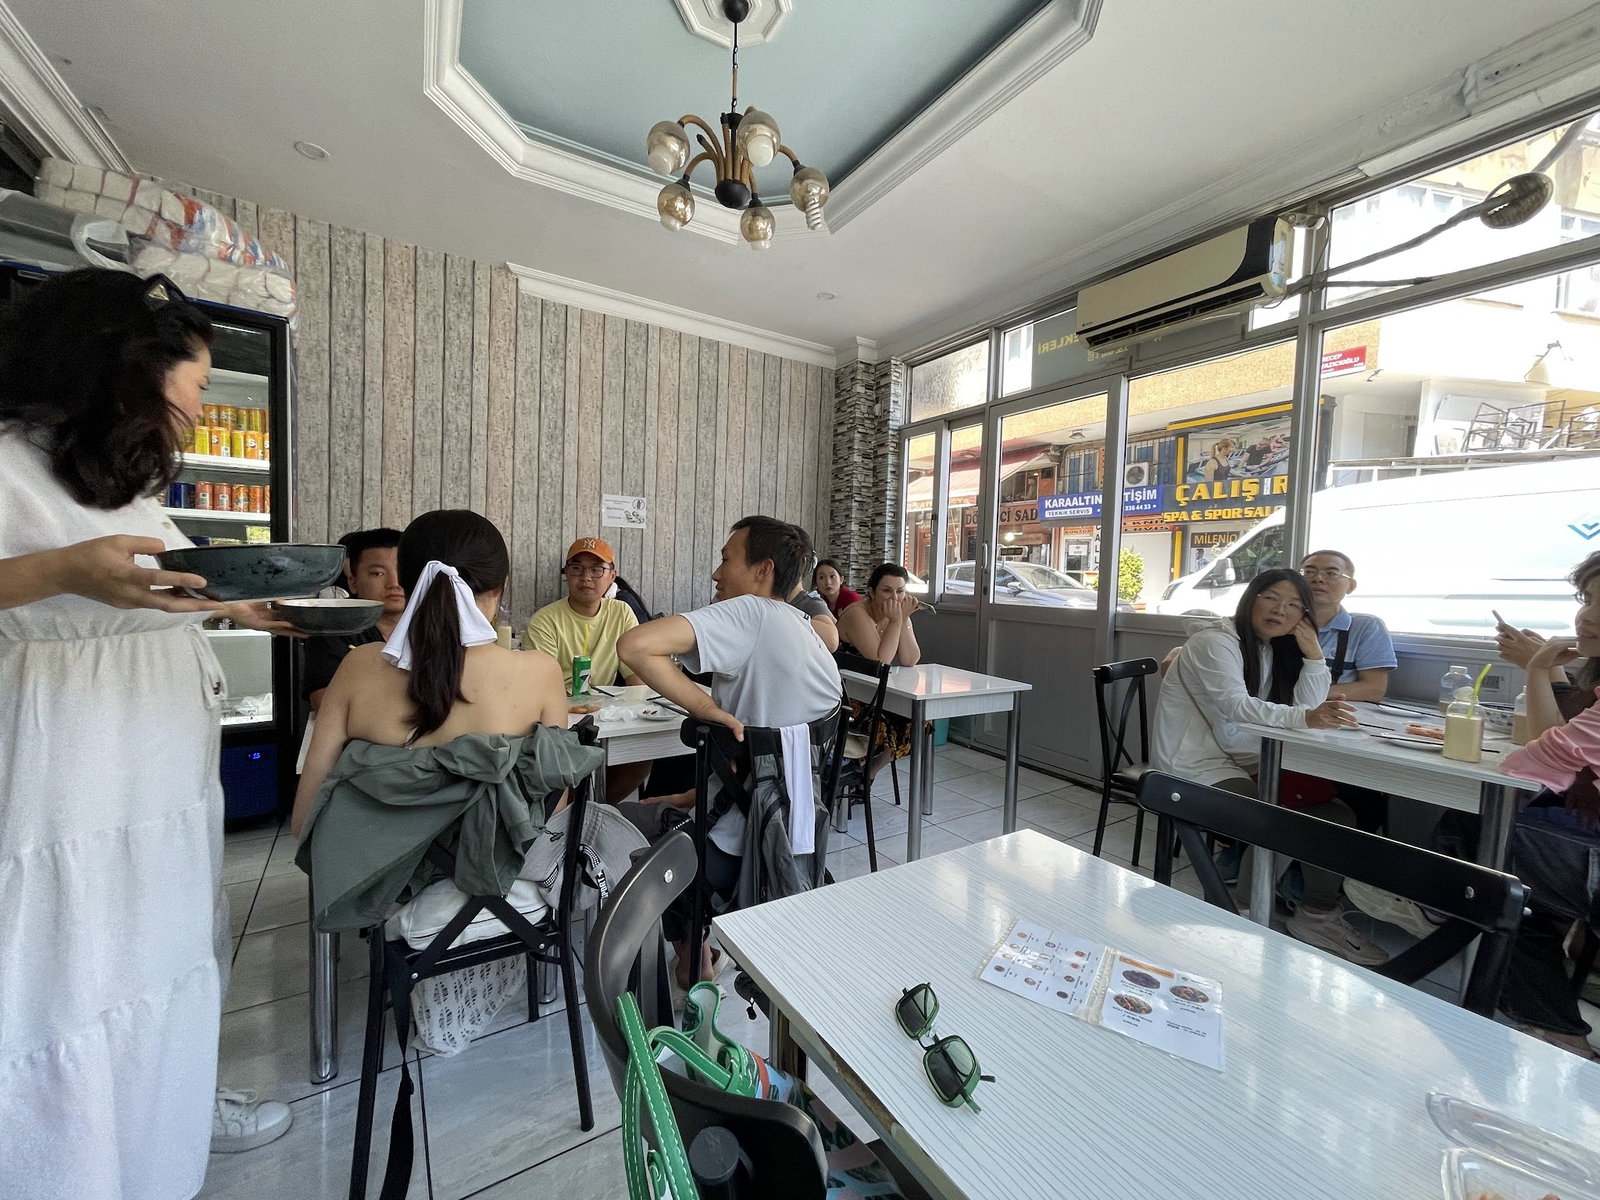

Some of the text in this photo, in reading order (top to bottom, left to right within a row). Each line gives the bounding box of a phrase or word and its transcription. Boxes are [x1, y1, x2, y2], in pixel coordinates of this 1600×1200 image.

[1045, 487, 1157, 509] KARAALTIN TİŞİM
[1163, 511, 1189, 522] SPA
[1190, 509, 1203, 520] &
[1204, 507, 1244, 520] SPOR
